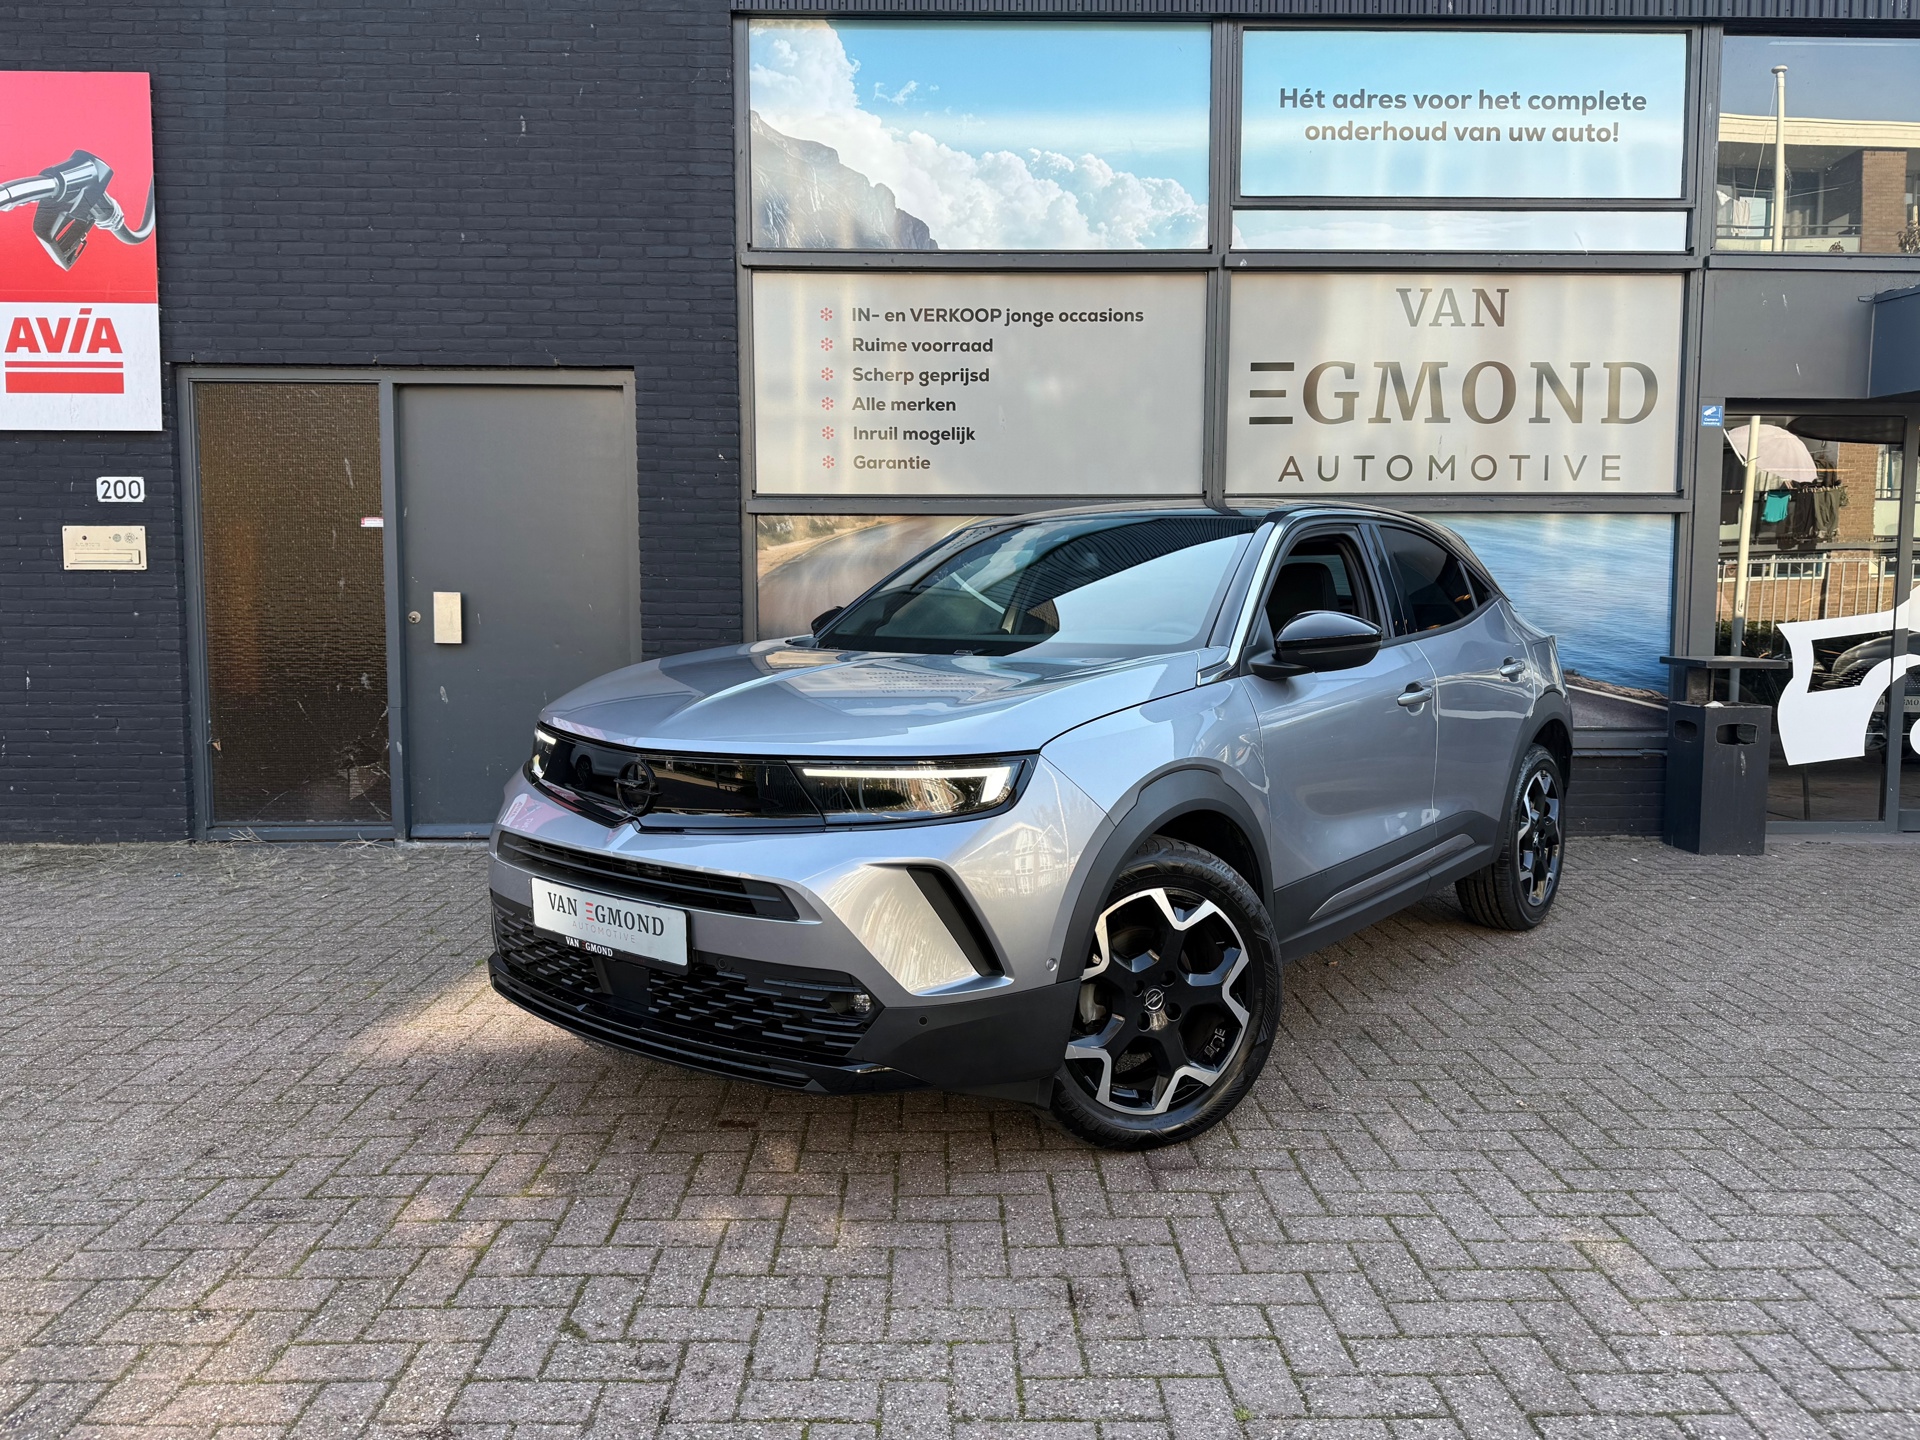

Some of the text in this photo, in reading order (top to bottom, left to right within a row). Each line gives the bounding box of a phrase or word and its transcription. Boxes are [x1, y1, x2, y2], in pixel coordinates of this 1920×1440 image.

[1279, 87, 1647, 115] Hét adres voor het complete
[1304, 120, 1619, 143] onderhoud van uw auto!
[851, 307, 1144, 327] IN- en VERKOOP jonge occasions
[1396, 287, 1510, 328] VAN
[4, 307, 123, 355] AVIA
[852, 337, 994, 353] Ruime voorraad
[852, 367, 990, 387] Scherp geprijsd
[1248, 360, 1659, 426] EGMOND
[851, 396, 957, 412] Alle merken
[853, 425, 976, 445] Inruil mogelijk
[852, 455, 931, 470] Garantie
[1278, 454, 1622, 483] AUTOMOTIVE
[100, 480, 141, 500] 200
[547, 891, 665, 937] VAN EGMOND
[565, 936, 580, 948] VAN
[572, 920, 636, 944] AUTOMOTIVE
